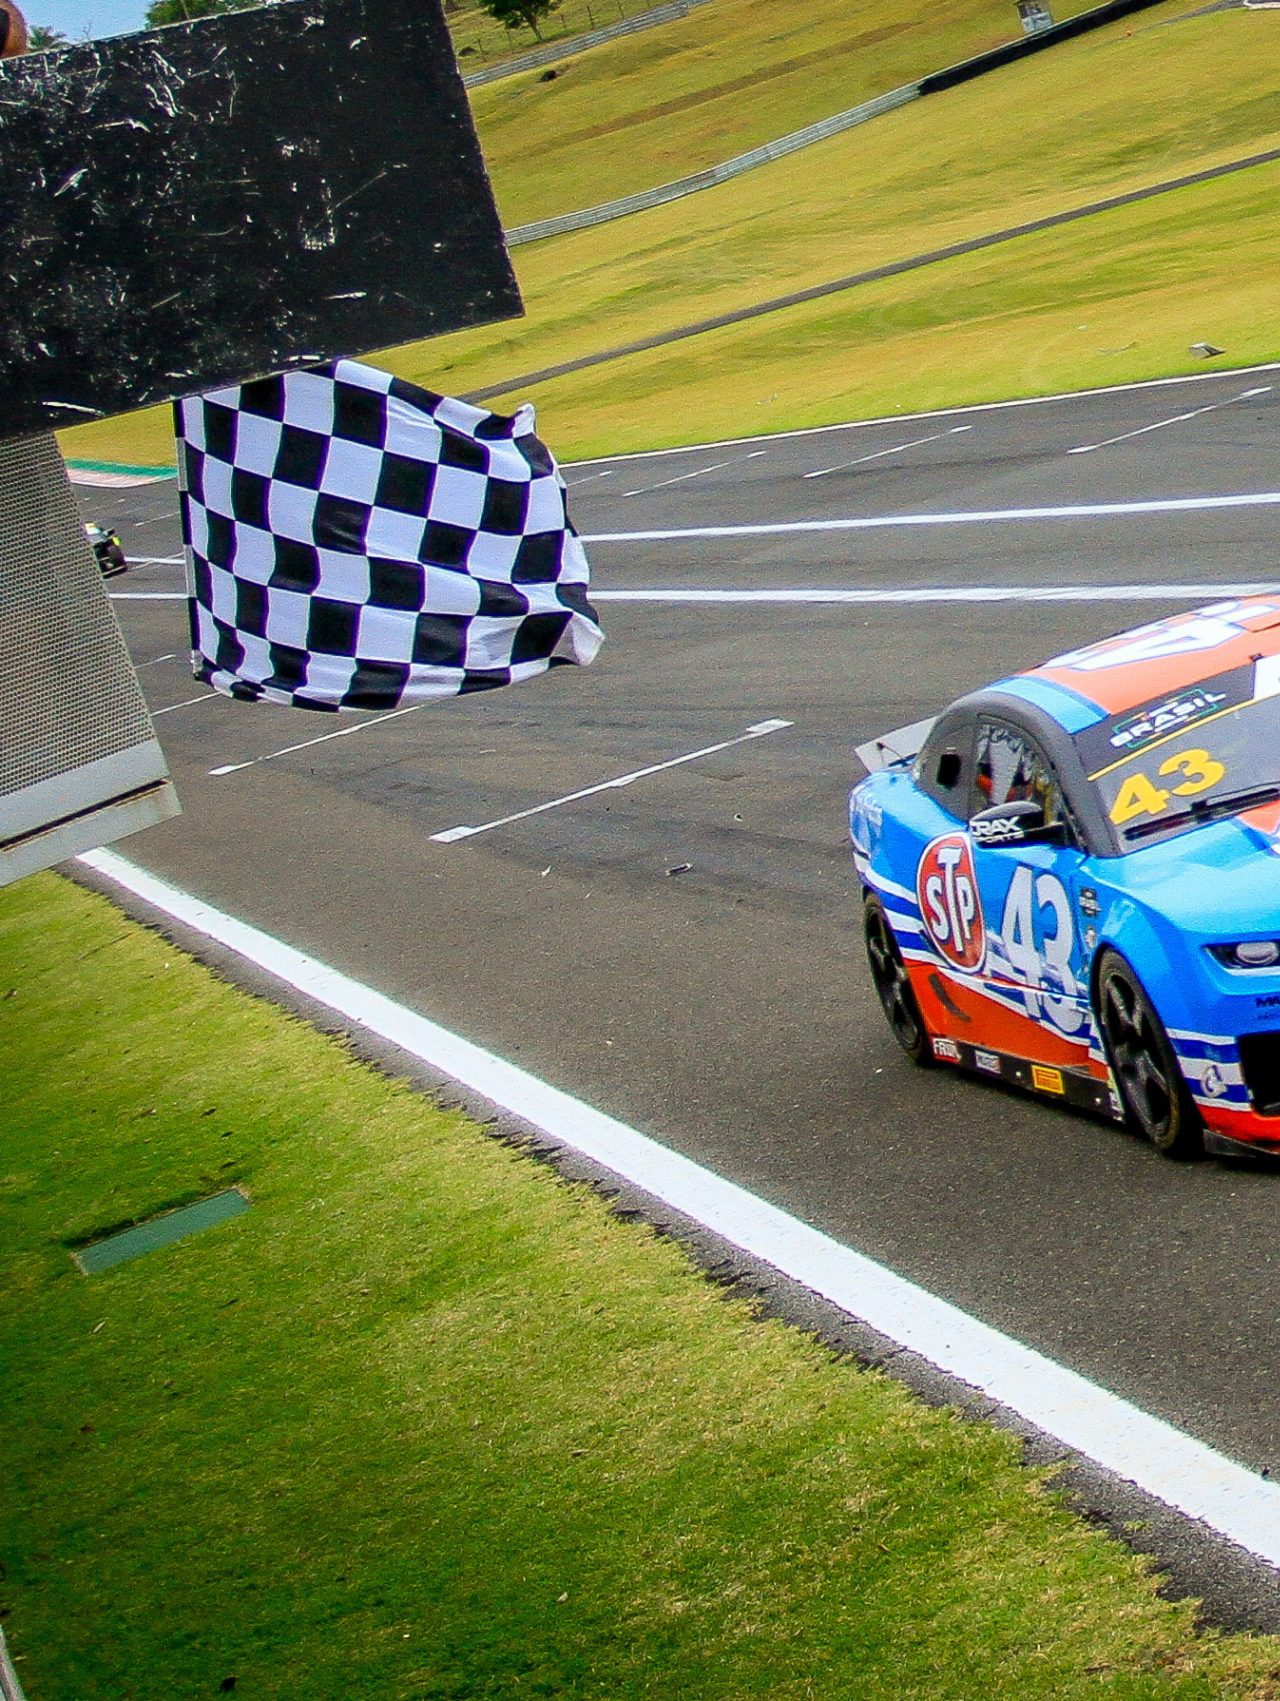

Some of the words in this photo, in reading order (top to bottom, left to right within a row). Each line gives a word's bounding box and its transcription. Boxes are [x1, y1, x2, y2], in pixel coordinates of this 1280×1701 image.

[1110, 693, 1226, 747] BRASIL
[1109, 748, 1225, 825] 43
[925, 846, 975, 953] STP
[1001, 864, 1085, 1034] 43
